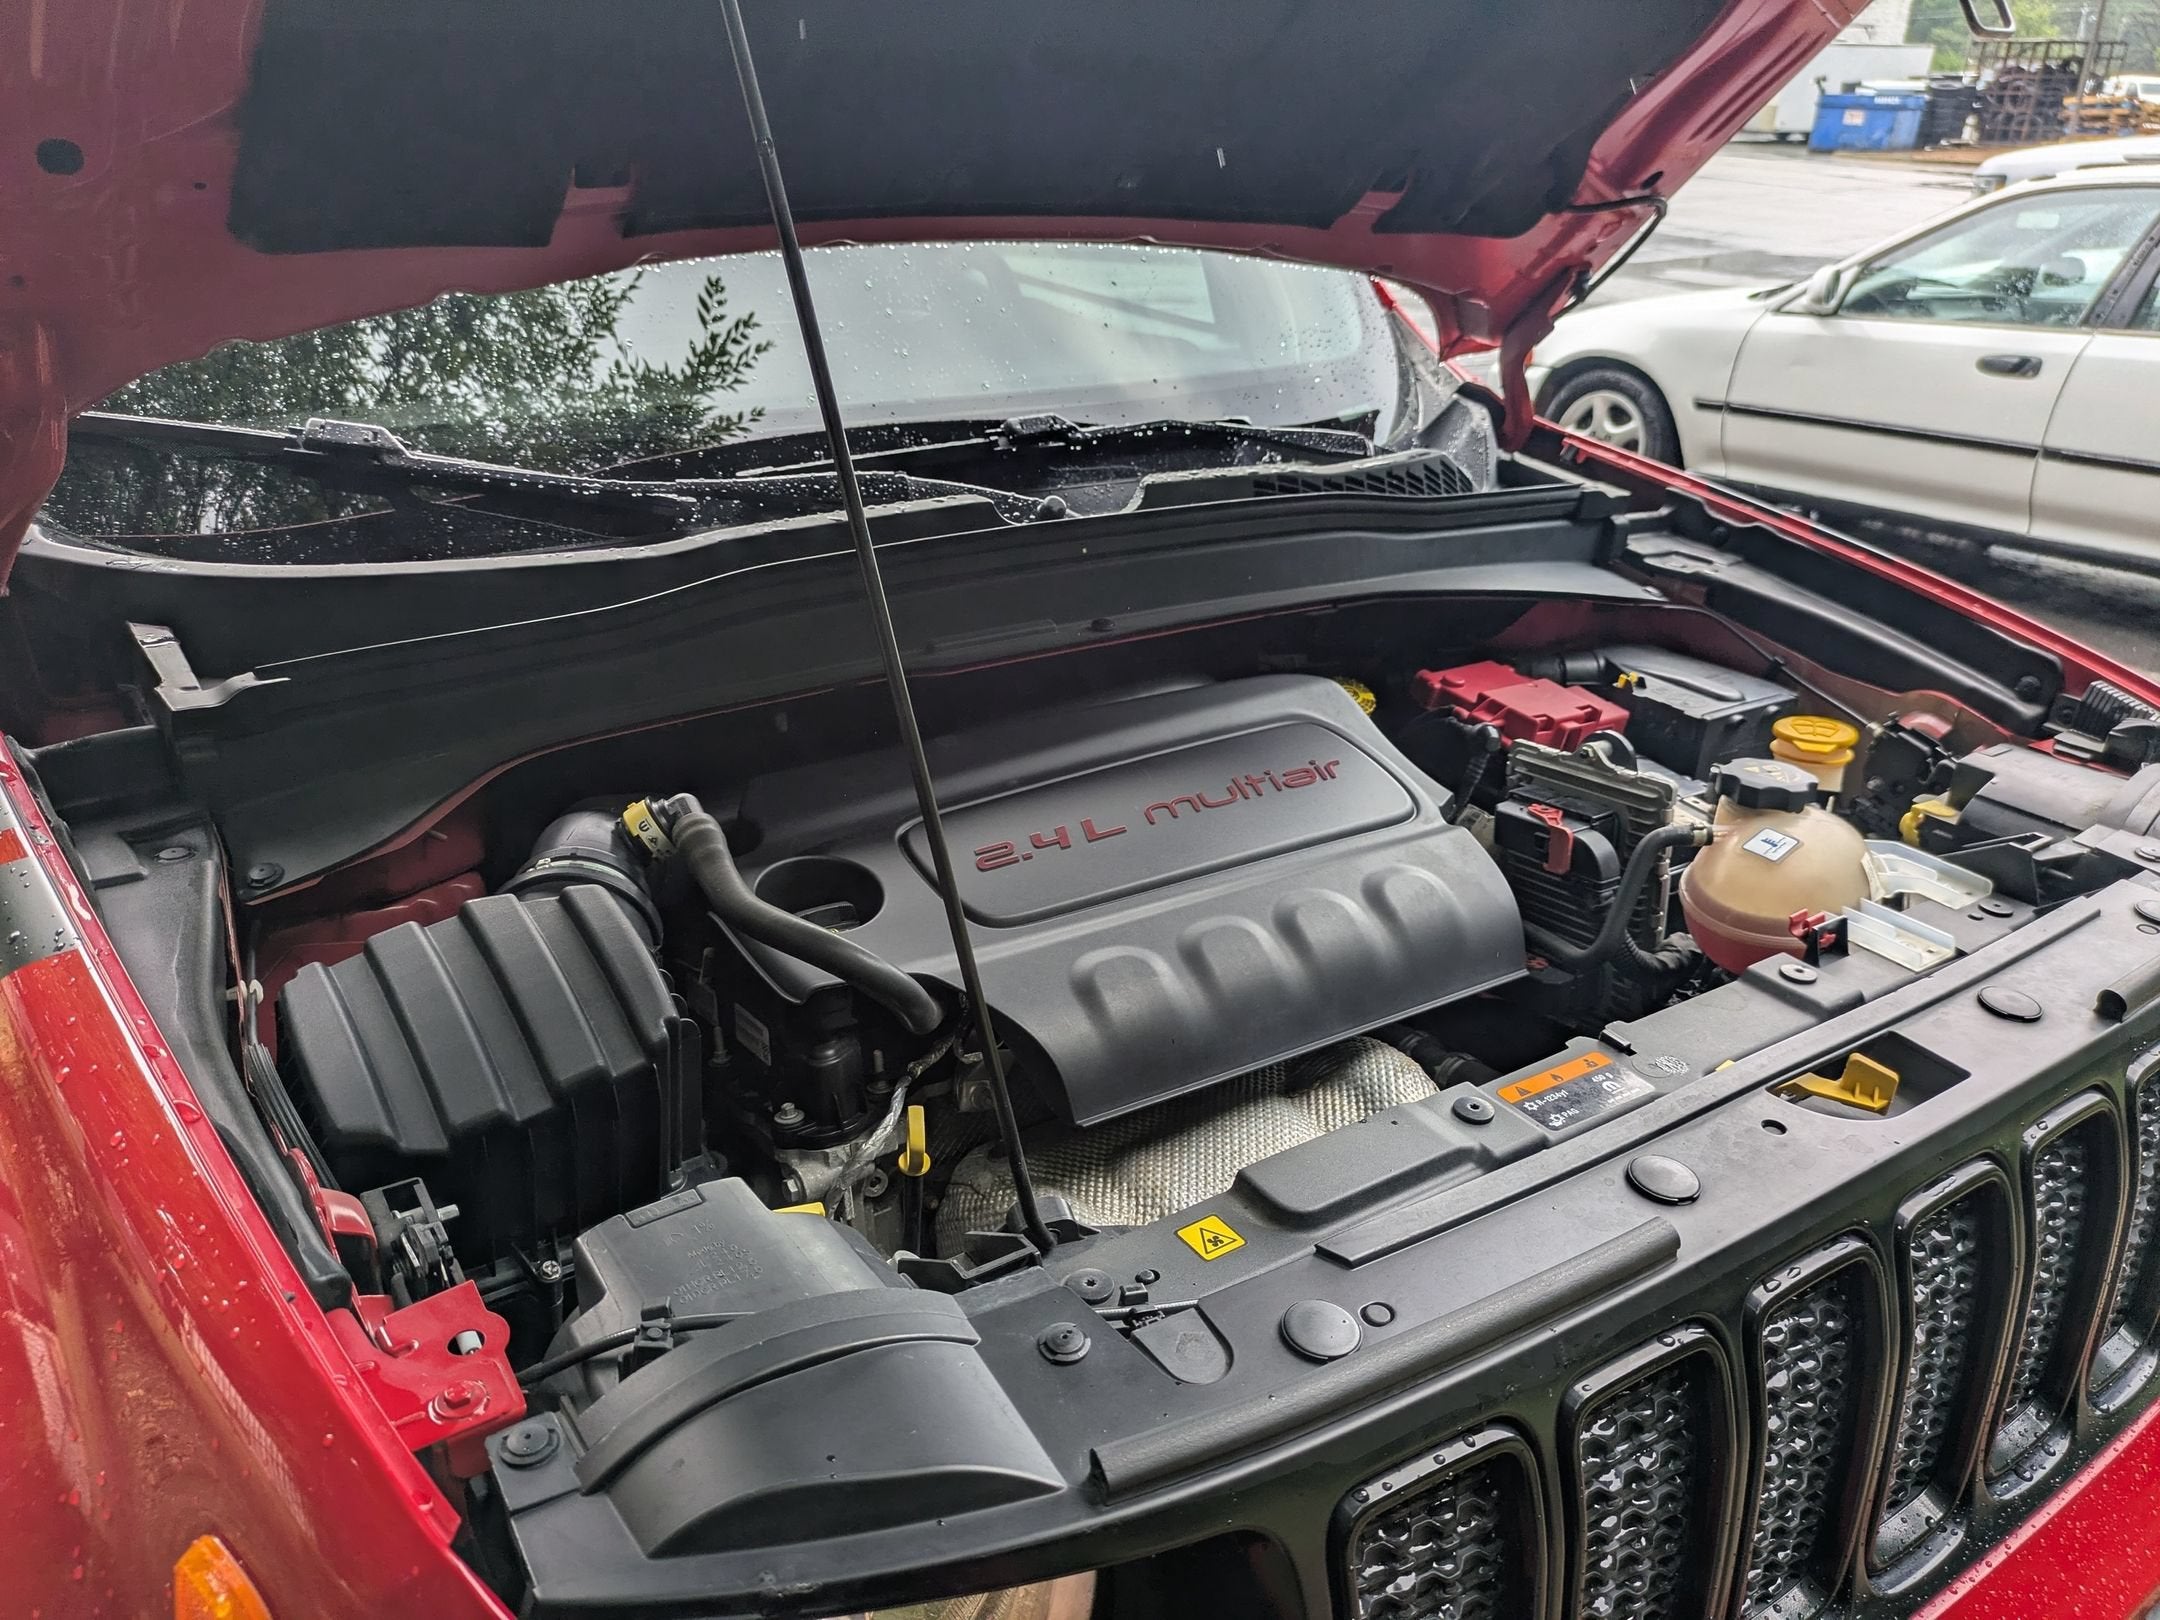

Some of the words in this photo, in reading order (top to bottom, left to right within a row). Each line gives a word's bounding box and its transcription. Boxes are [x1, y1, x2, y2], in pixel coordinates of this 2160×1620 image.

[975, 824, 1071, 872] 2.4
[1081, 817, 1127, 842] L
[1143, 759, 1340, 825] multiair
